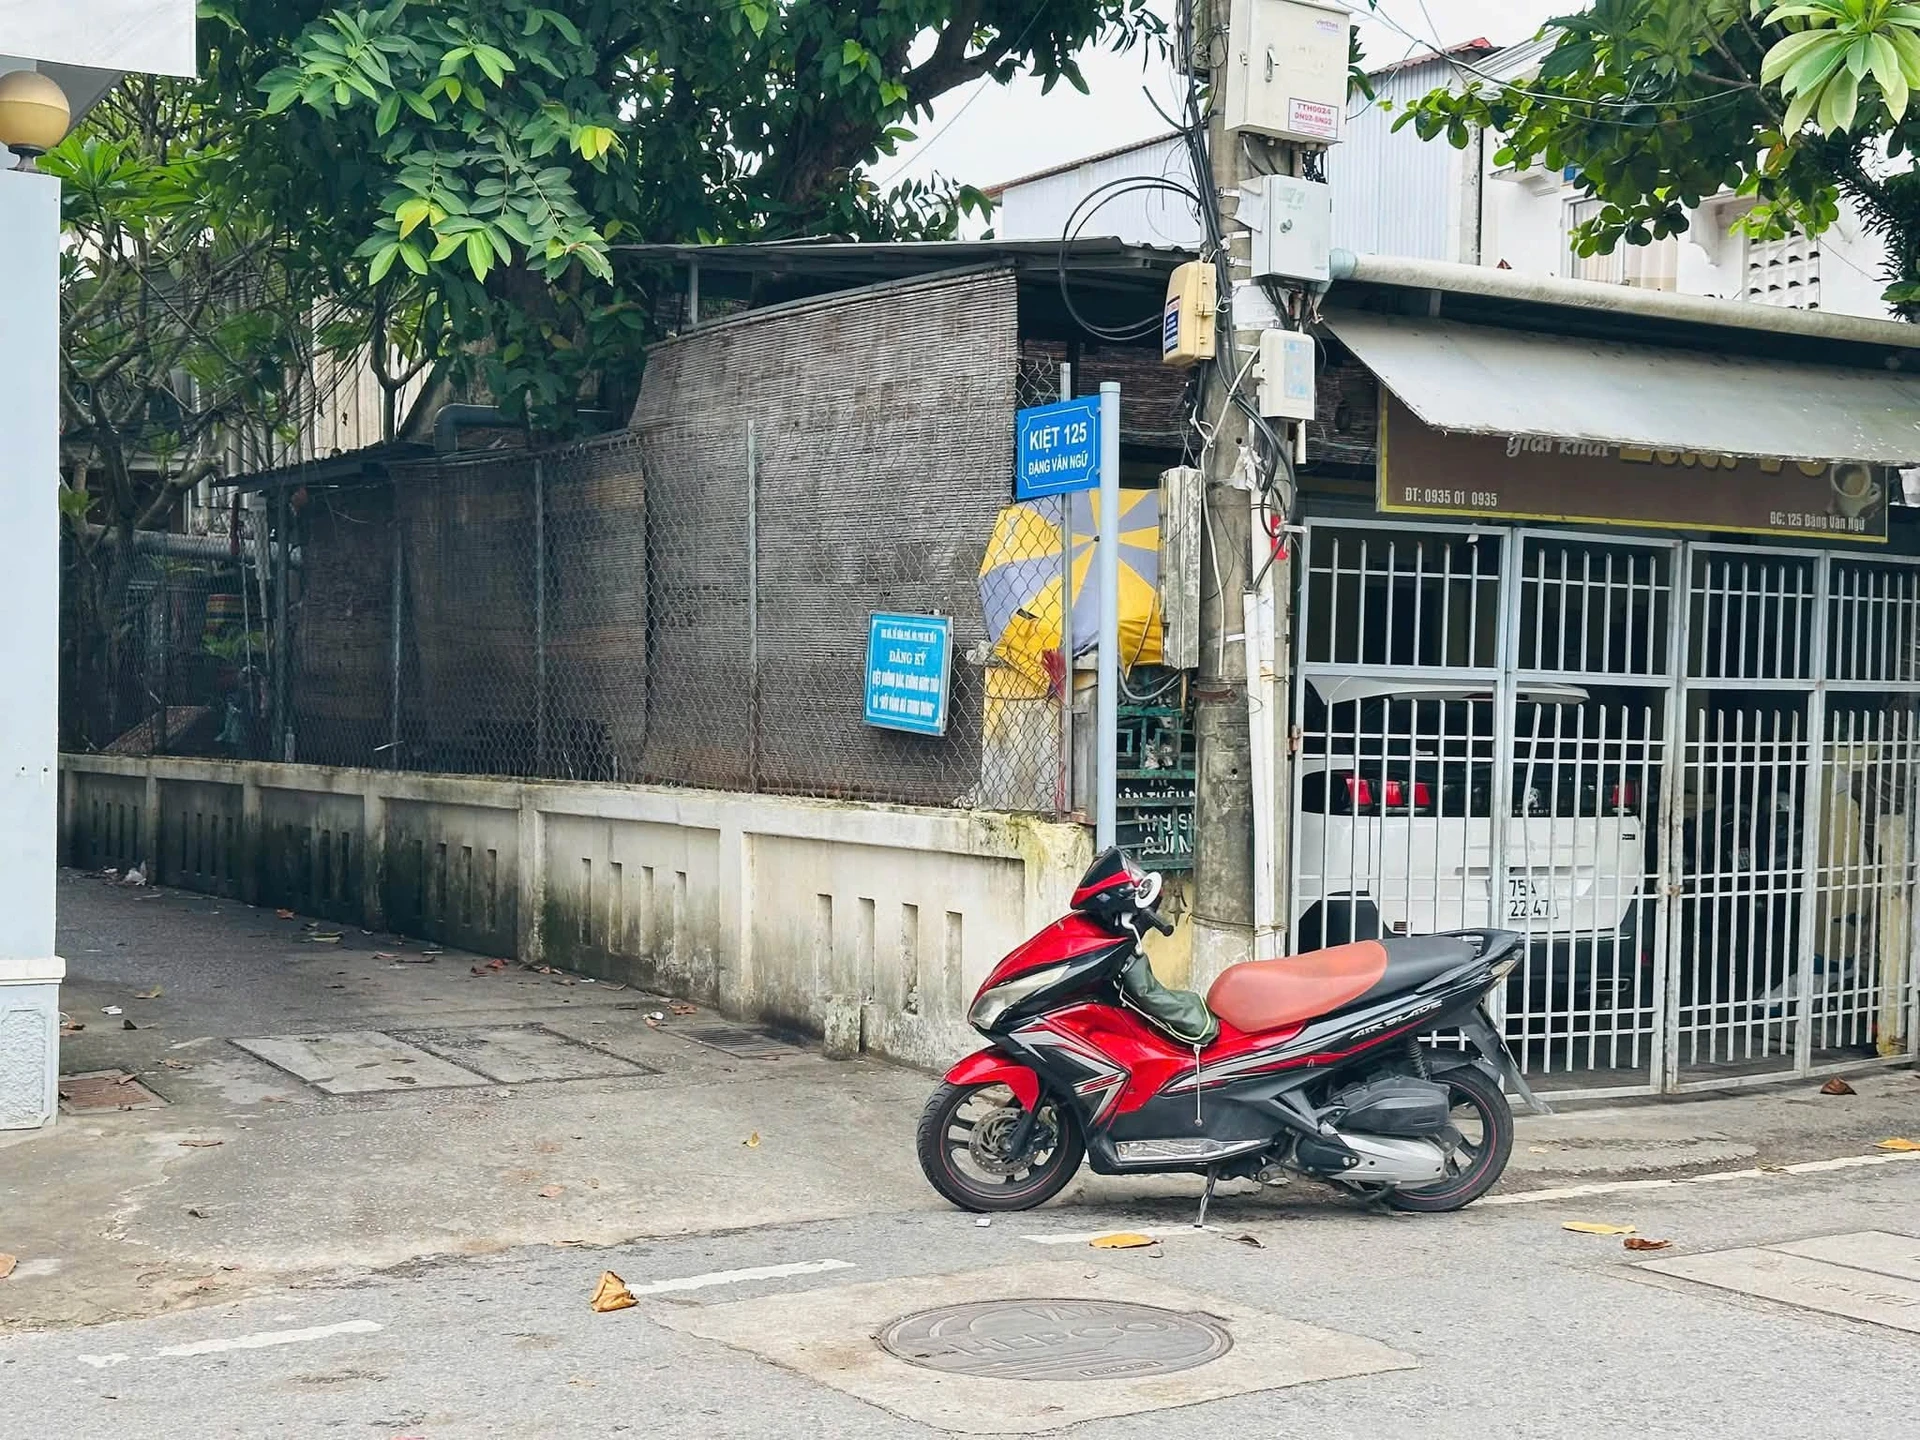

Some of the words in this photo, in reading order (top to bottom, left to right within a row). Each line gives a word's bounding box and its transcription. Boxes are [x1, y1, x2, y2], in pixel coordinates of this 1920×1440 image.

[1030, 425, 1060, 453] KIỆT
[1064, 422, 1087, 445] 125
[1028, 459, 1050, 478] ĐẶNG
[1052, 454, 1068, 471] VĂN
[1069, 450, 1088, 470] NGỮ
[1405, 487, 1421, 502] ĐT:
[1425, 488, 1451, 504] 0935
[1454, 490, 1465, 505] 01
[1471, 491, 1498, 507] 0935
[1787, 512, 1802, 526] 125
